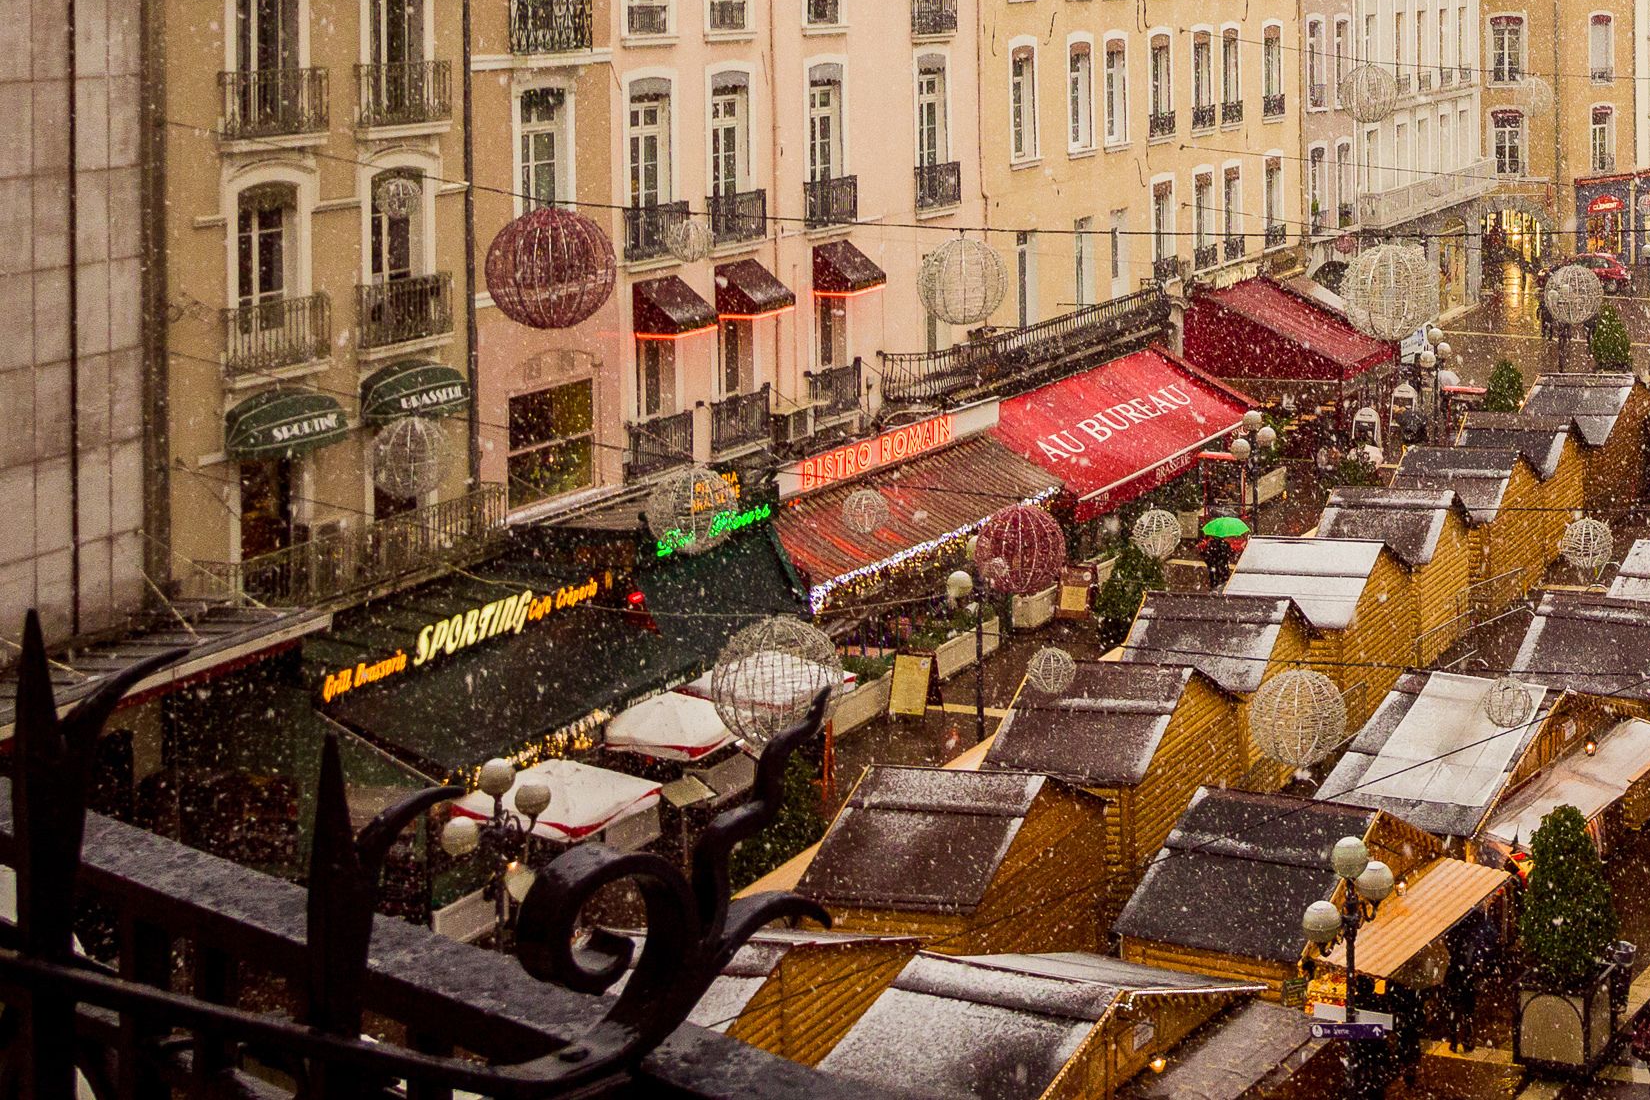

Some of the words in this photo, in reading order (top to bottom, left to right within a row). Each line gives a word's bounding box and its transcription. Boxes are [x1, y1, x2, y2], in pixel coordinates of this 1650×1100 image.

[803, 442, 872, 489] BISTRO
[880, 416, 952, 462] ROMAIN
[1036, 429, 1086, 463] AU
[1076, 383, 1192, 443] BUREAU
[1155, 452, 1191, 480] BRASSERIE
[413, 590, 533, 666] SPORTING
